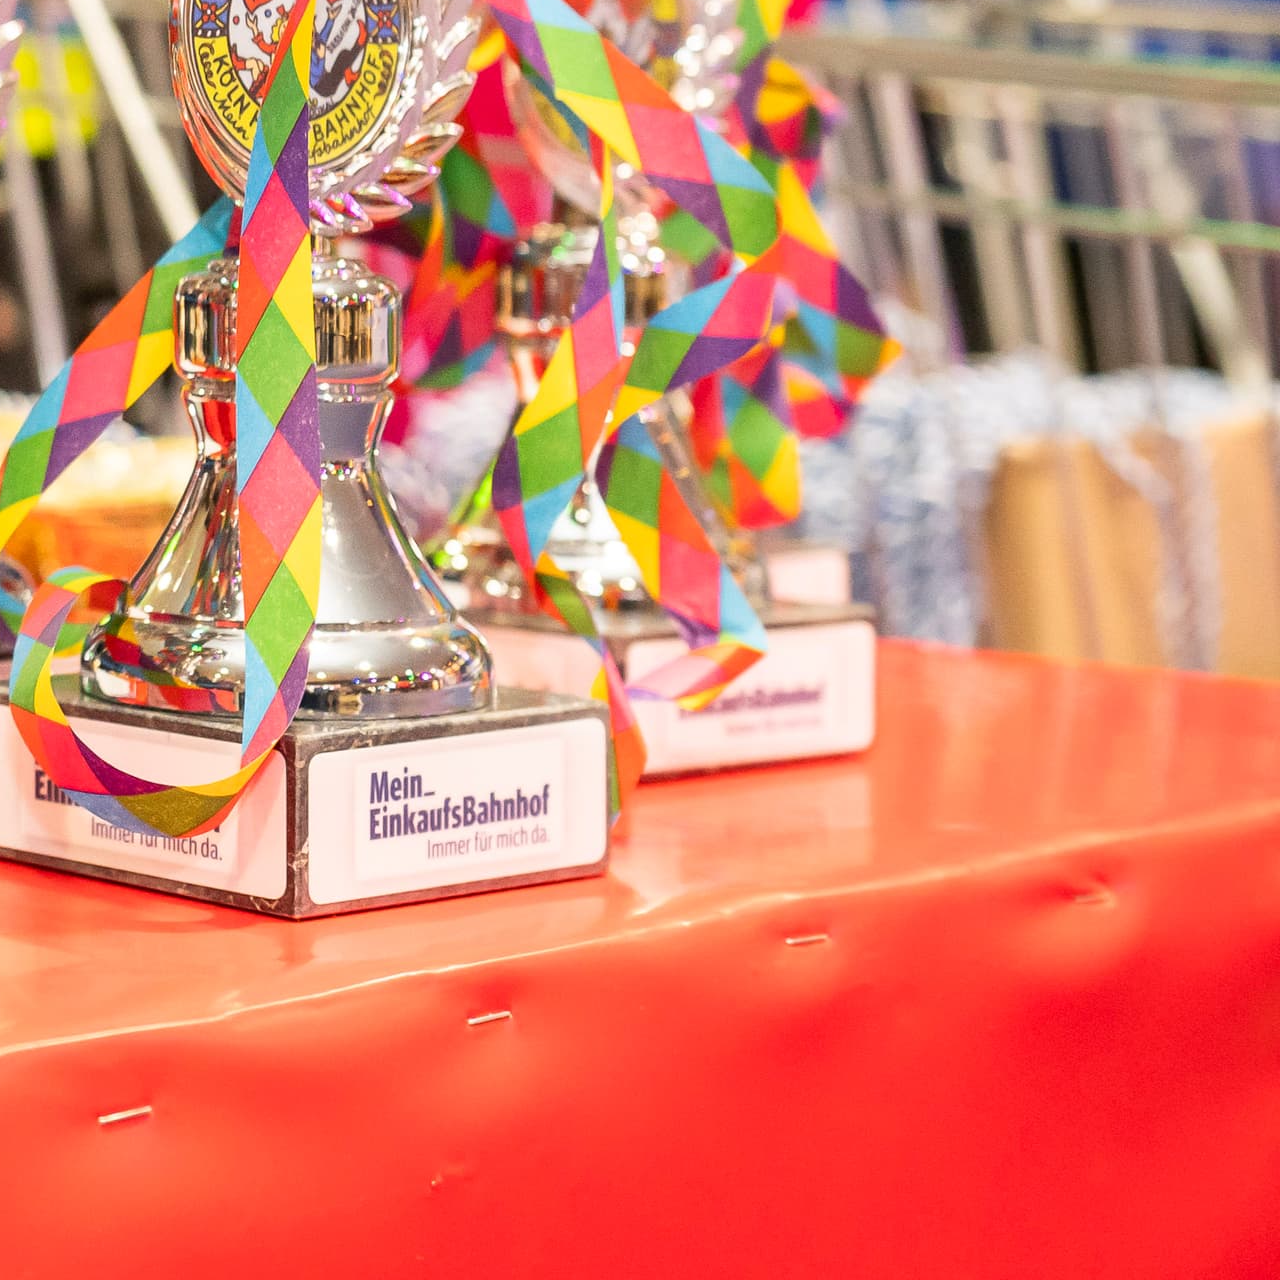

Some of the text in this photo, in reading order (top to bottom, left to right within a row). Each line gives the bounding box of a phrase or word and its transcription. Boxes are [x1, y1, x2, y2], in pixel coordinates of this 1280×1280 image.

[213, 54, 251, 116] KÖLN
[370, 767, 435, 804] Mein_
[369, 784, 550, 841] EinkaufsBahnhof
[201, 837, 223, 861] da.
[427, 840, 470, 860] Immer
[474, 832, 493, 853] für
[496, 825, 528, 849] mich
